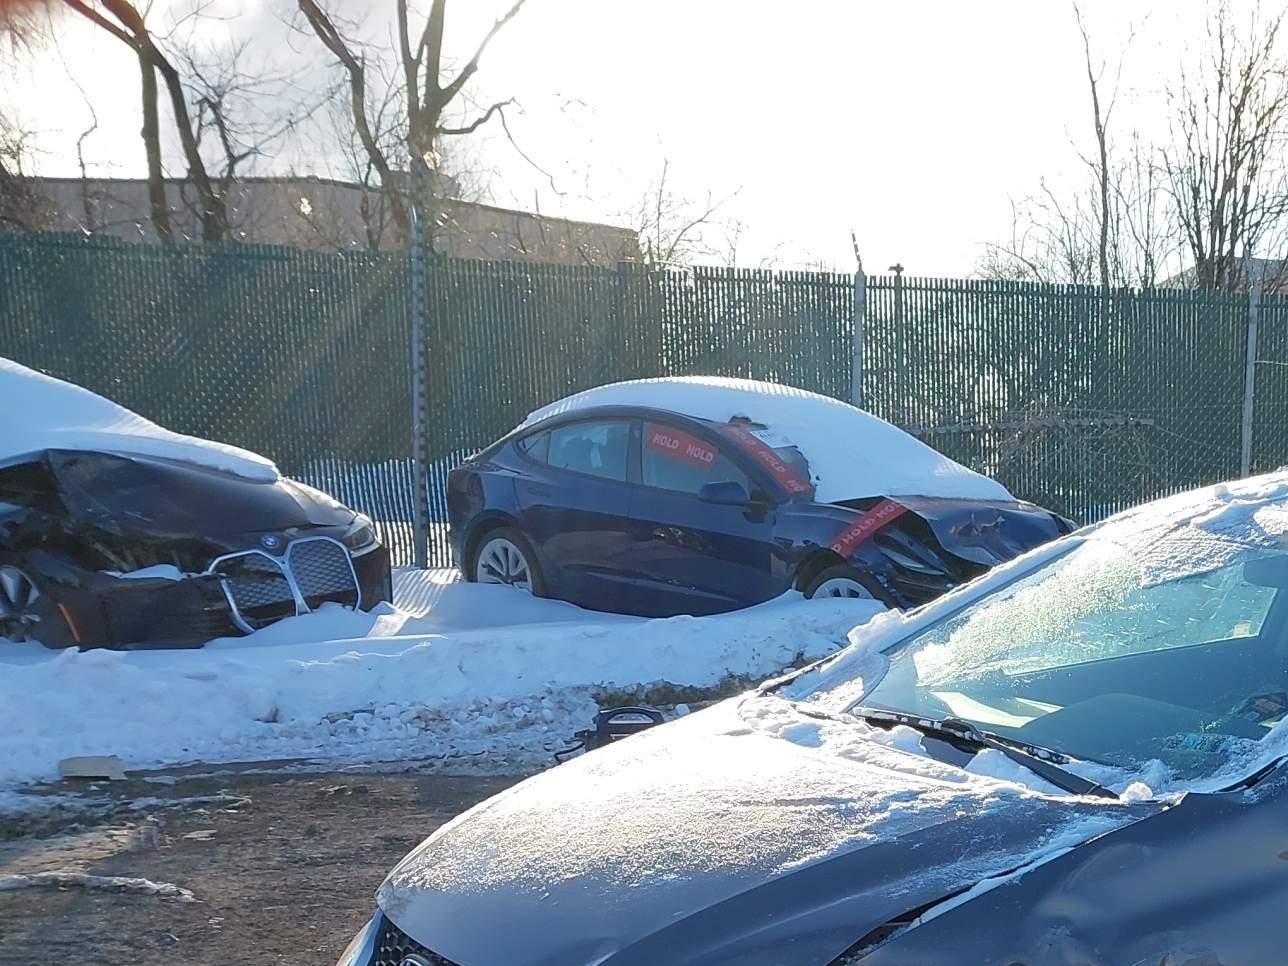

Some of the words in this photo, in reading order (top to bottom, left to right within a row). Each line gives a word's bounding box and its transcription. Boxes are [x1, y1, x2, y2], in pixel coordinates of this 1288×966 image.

[652, 433, 680, 449] HOLD
[686, 443, 714, 462] HOLD
[842, 518, 875, 544] HOLD
